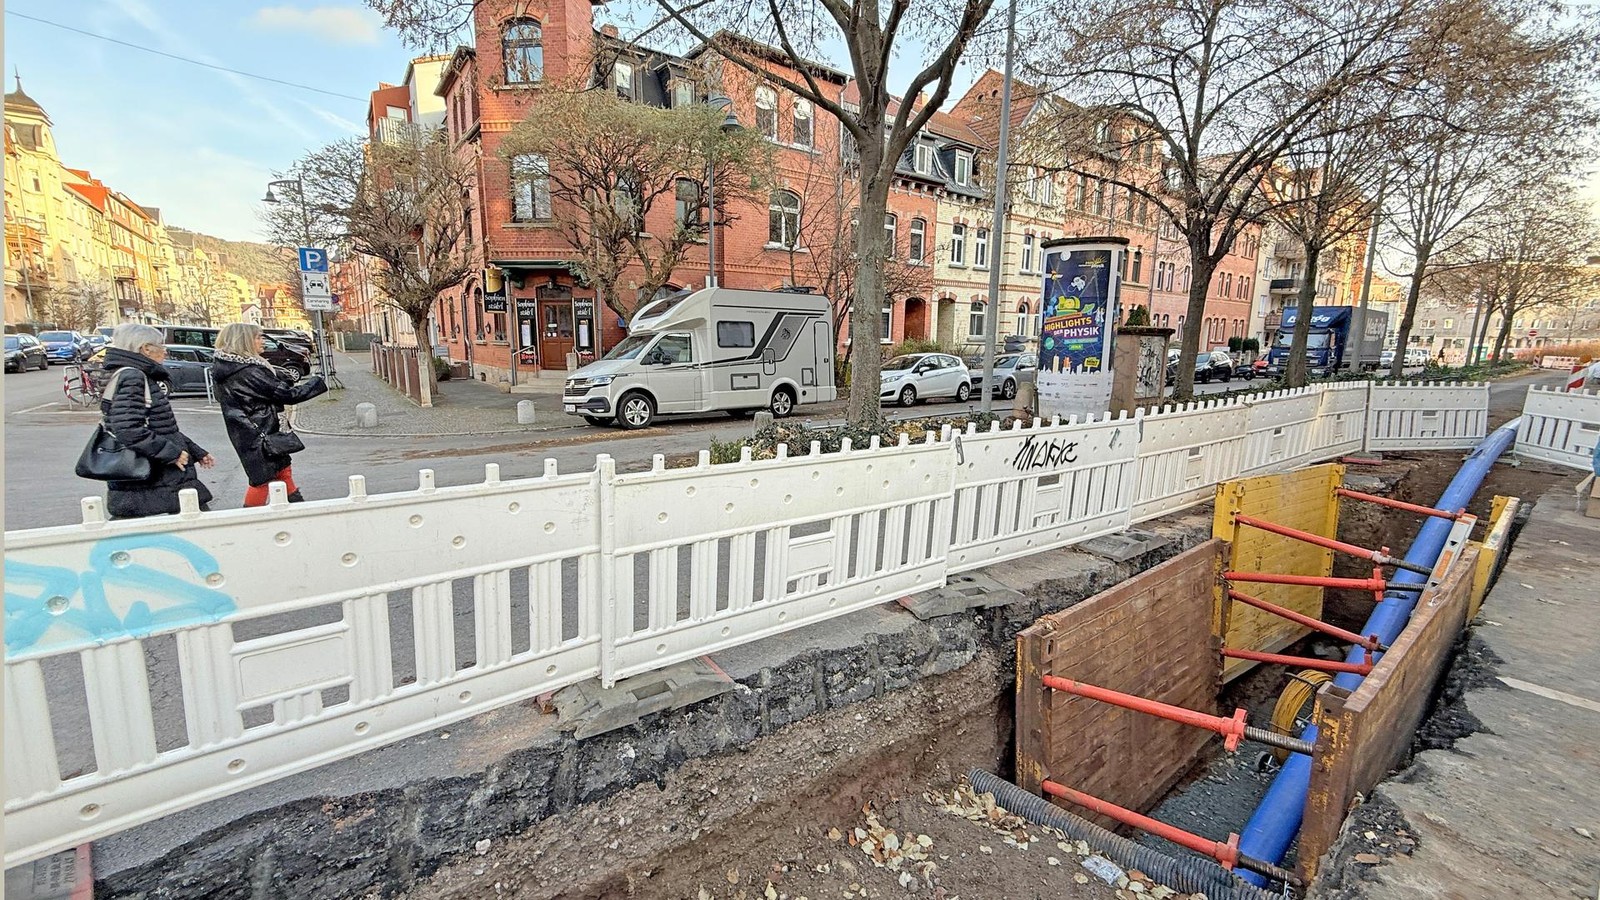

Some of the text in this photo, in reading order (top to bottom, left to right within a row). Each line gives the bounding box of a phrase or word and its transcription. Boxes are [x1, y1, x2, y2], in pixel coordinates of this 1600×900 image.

[305, 250, 321, 269] P
[1044, 316, 1092, 332] HIGHLIGHTS
[1063, 326, 1100, 338] PHYSIK
